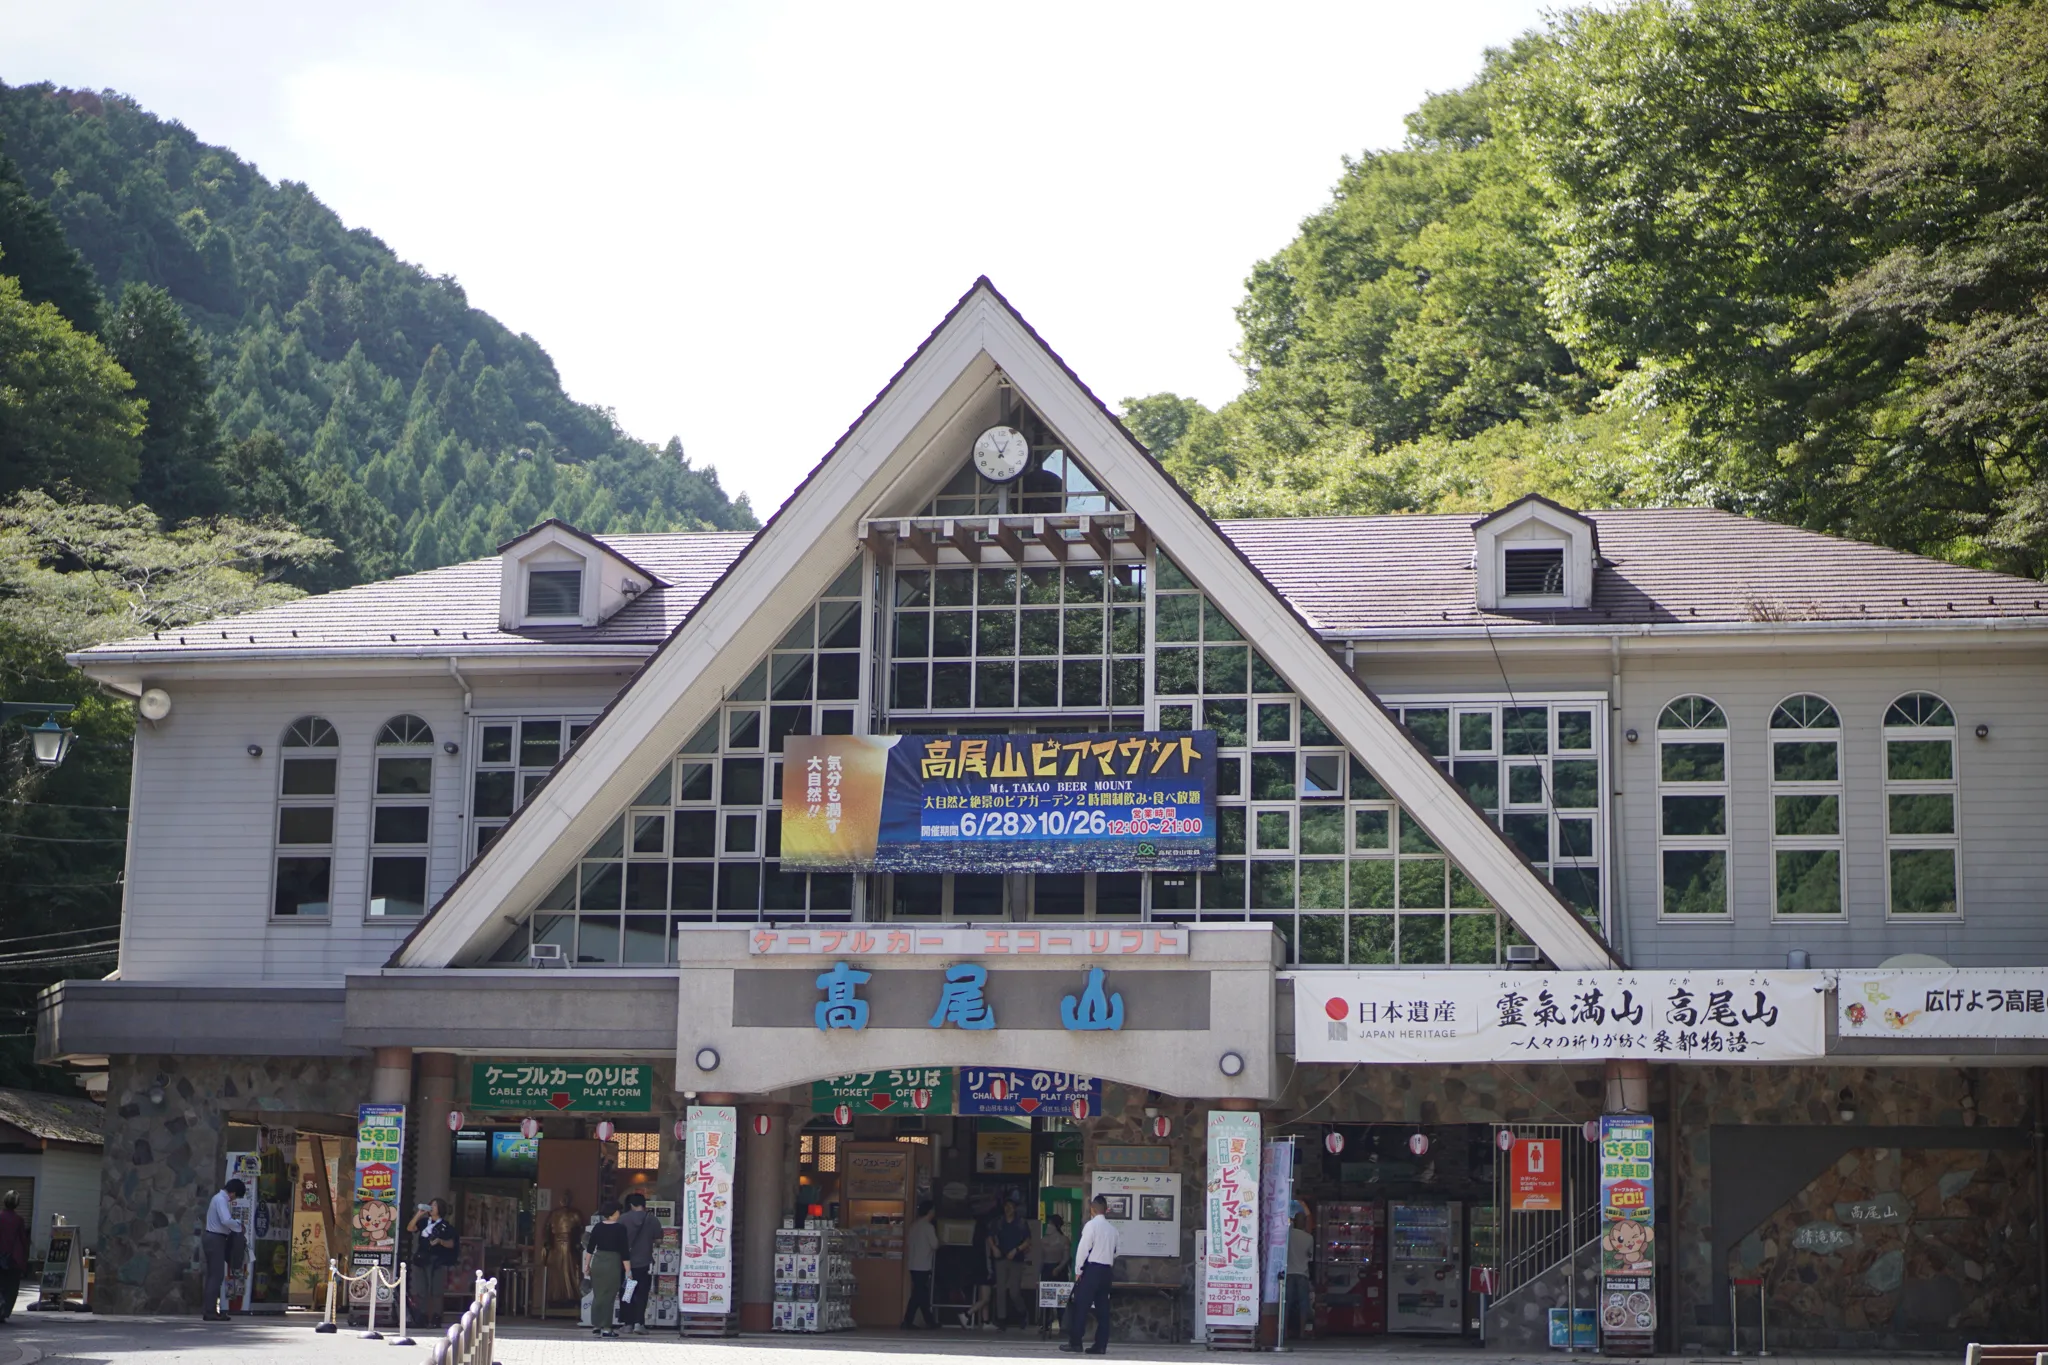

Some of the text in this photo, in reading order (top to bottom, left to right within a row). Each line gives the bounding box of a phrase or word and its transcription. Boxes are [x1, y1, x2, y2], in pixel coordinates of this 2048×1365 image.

[921, 737, 1201, 779] 高尾山ビアマウント
[990, 780, 1132, 793] Mt. TAKAO BEER MOUNT
[826, 755, 842, 834] 気分も潤す
[1132, 808, 1175, 819] 営業時間
[921, 825, 959, 837] 開催期間
[753, 930, 943, 953] ケーブルカー
[1666, 987, 1778, 1027] 高尾山
[1925, 989, 2048, 1012] 広げよう高尾
[1360, 1000, 1456, 1023] 日本遺産
[1360, 1029, 1456, 1038] JAPAN HERITAGE
[485, 1066, 640, 1086] ケーブルカーのりば
[889, 1070, 941, 1086] うりば
[1031, 1072, 1093, 1091] のりば
[489, 1087, 548, 1096] CABLE CAR
[583, 1088, 641, 1097] PLAT FORM
[833, 1088, 869, 1097] TICKET
[1040, 1093, 1062, 1101] PLAT
[361, 1128, 398, 1142] さる園
[706, 1132, 721, 1157] 夏の
[1230, 1138, 1246, 1164] 夏の
[1605, 1142, 1649, 1157] さる園
[1605, 1163, 1650, 1178] 野草園
[363, 1174, 391, 1187] GO!!
[698, 1158, 715, 1253] ビアマウント
[1611, 1192, 1644, 1206] GO!!
[1222, 1166, 1241, 1263] ビアマウント
[1851, 1205, 1898, 1219] 高尾山
[1801, 1229, 1844, 1244] 清滝駅
